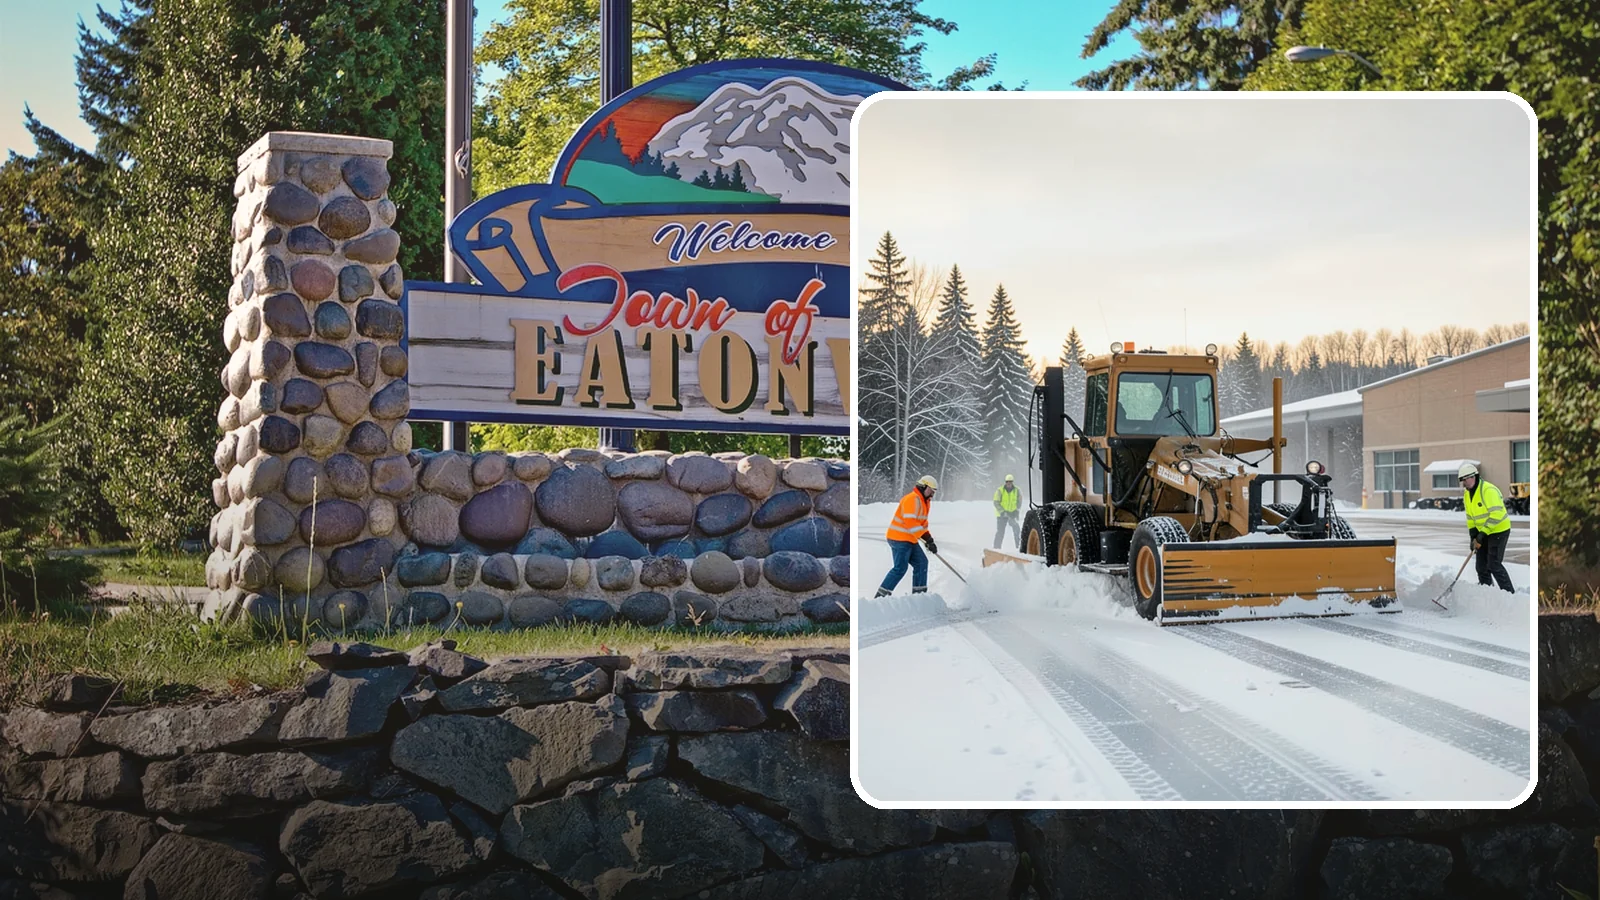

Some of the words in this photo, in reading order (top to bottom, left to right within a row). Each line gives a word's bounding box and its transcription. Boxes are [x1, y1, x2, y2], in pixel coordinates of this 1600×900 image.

[654, 221, 837, 263] Welcome
[556, 264, 737, 336] Town
[765, 278, 826, 365] of
